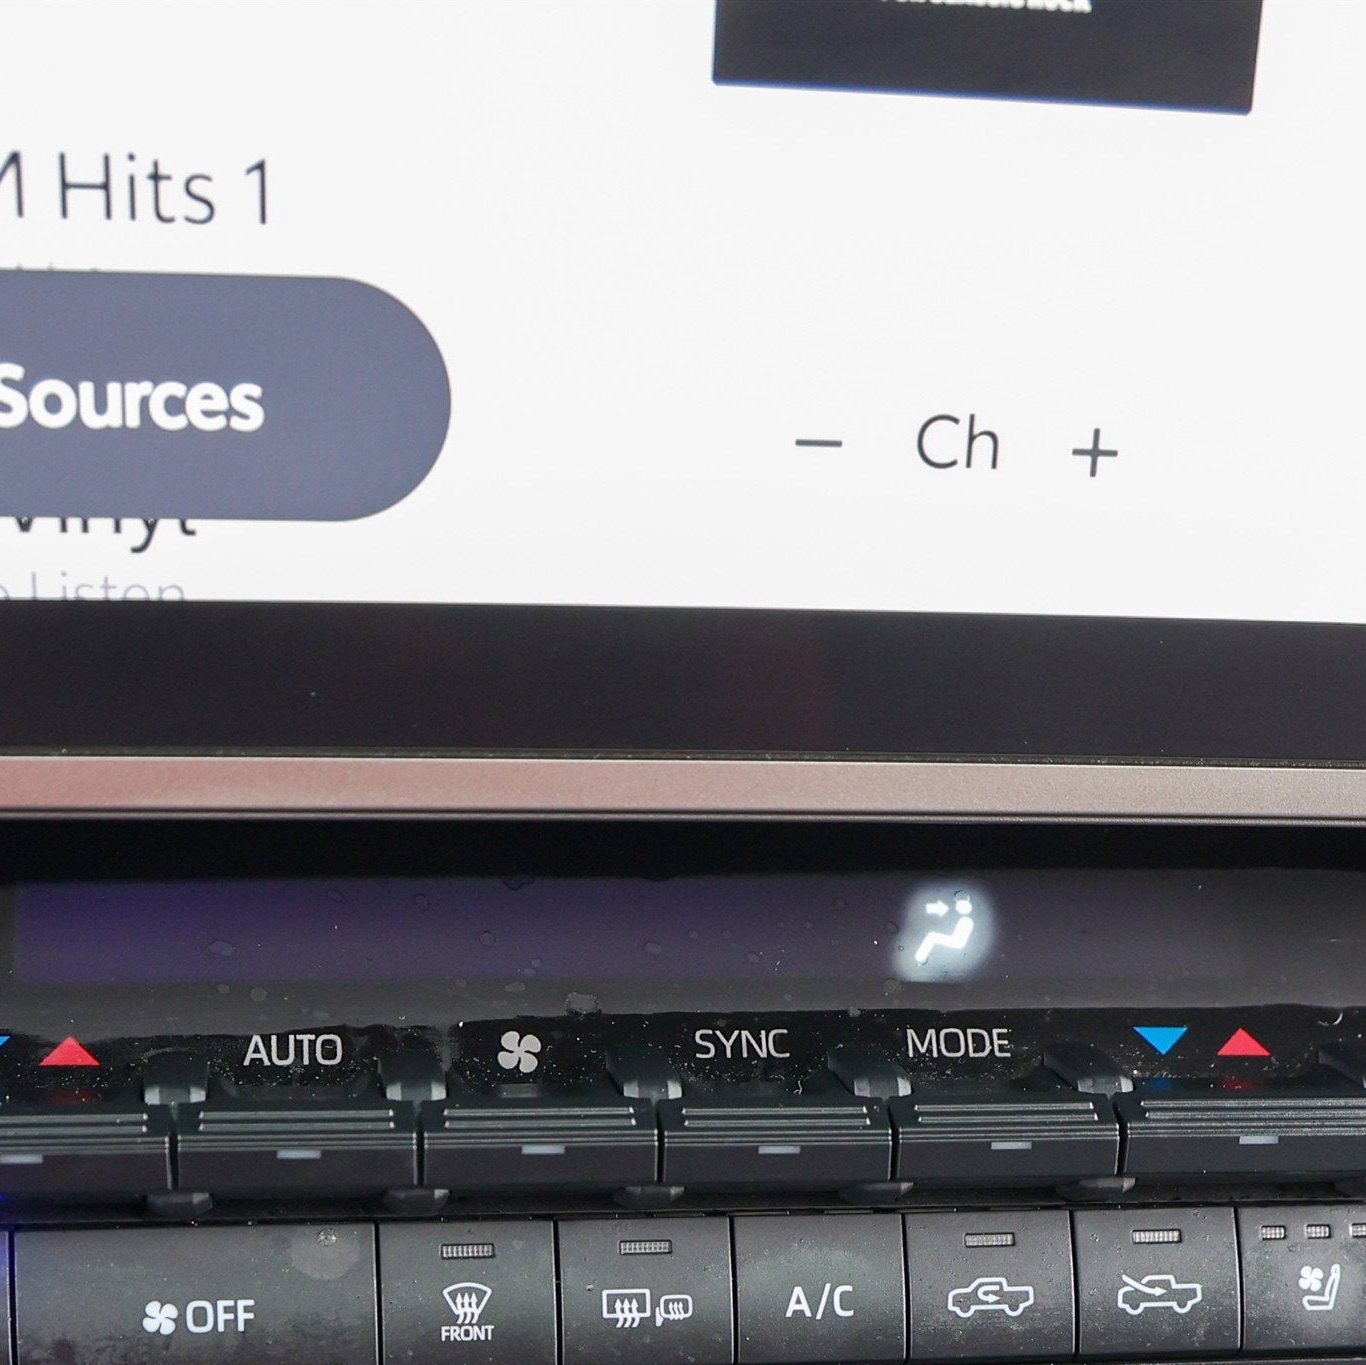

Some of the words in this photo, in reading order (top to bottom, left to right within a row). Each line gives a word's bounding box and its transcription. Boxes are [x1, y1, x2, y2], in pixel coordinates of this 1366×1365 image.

[58, 151, 216, 226] Hits
[243, 157, 270, 226] 1
[915, 412, 1000, 471] Ch
[243, 1033, 344, 1067] AUTO
[693, 1027, 791, 1060] SYNC
[906, 1027, 1012, 1059] MODE
[185, 1299, 255, 1333] OFF
[785, 1281, 854, 1320] A/C
[441, 1323, 495, 1342] FRONT
